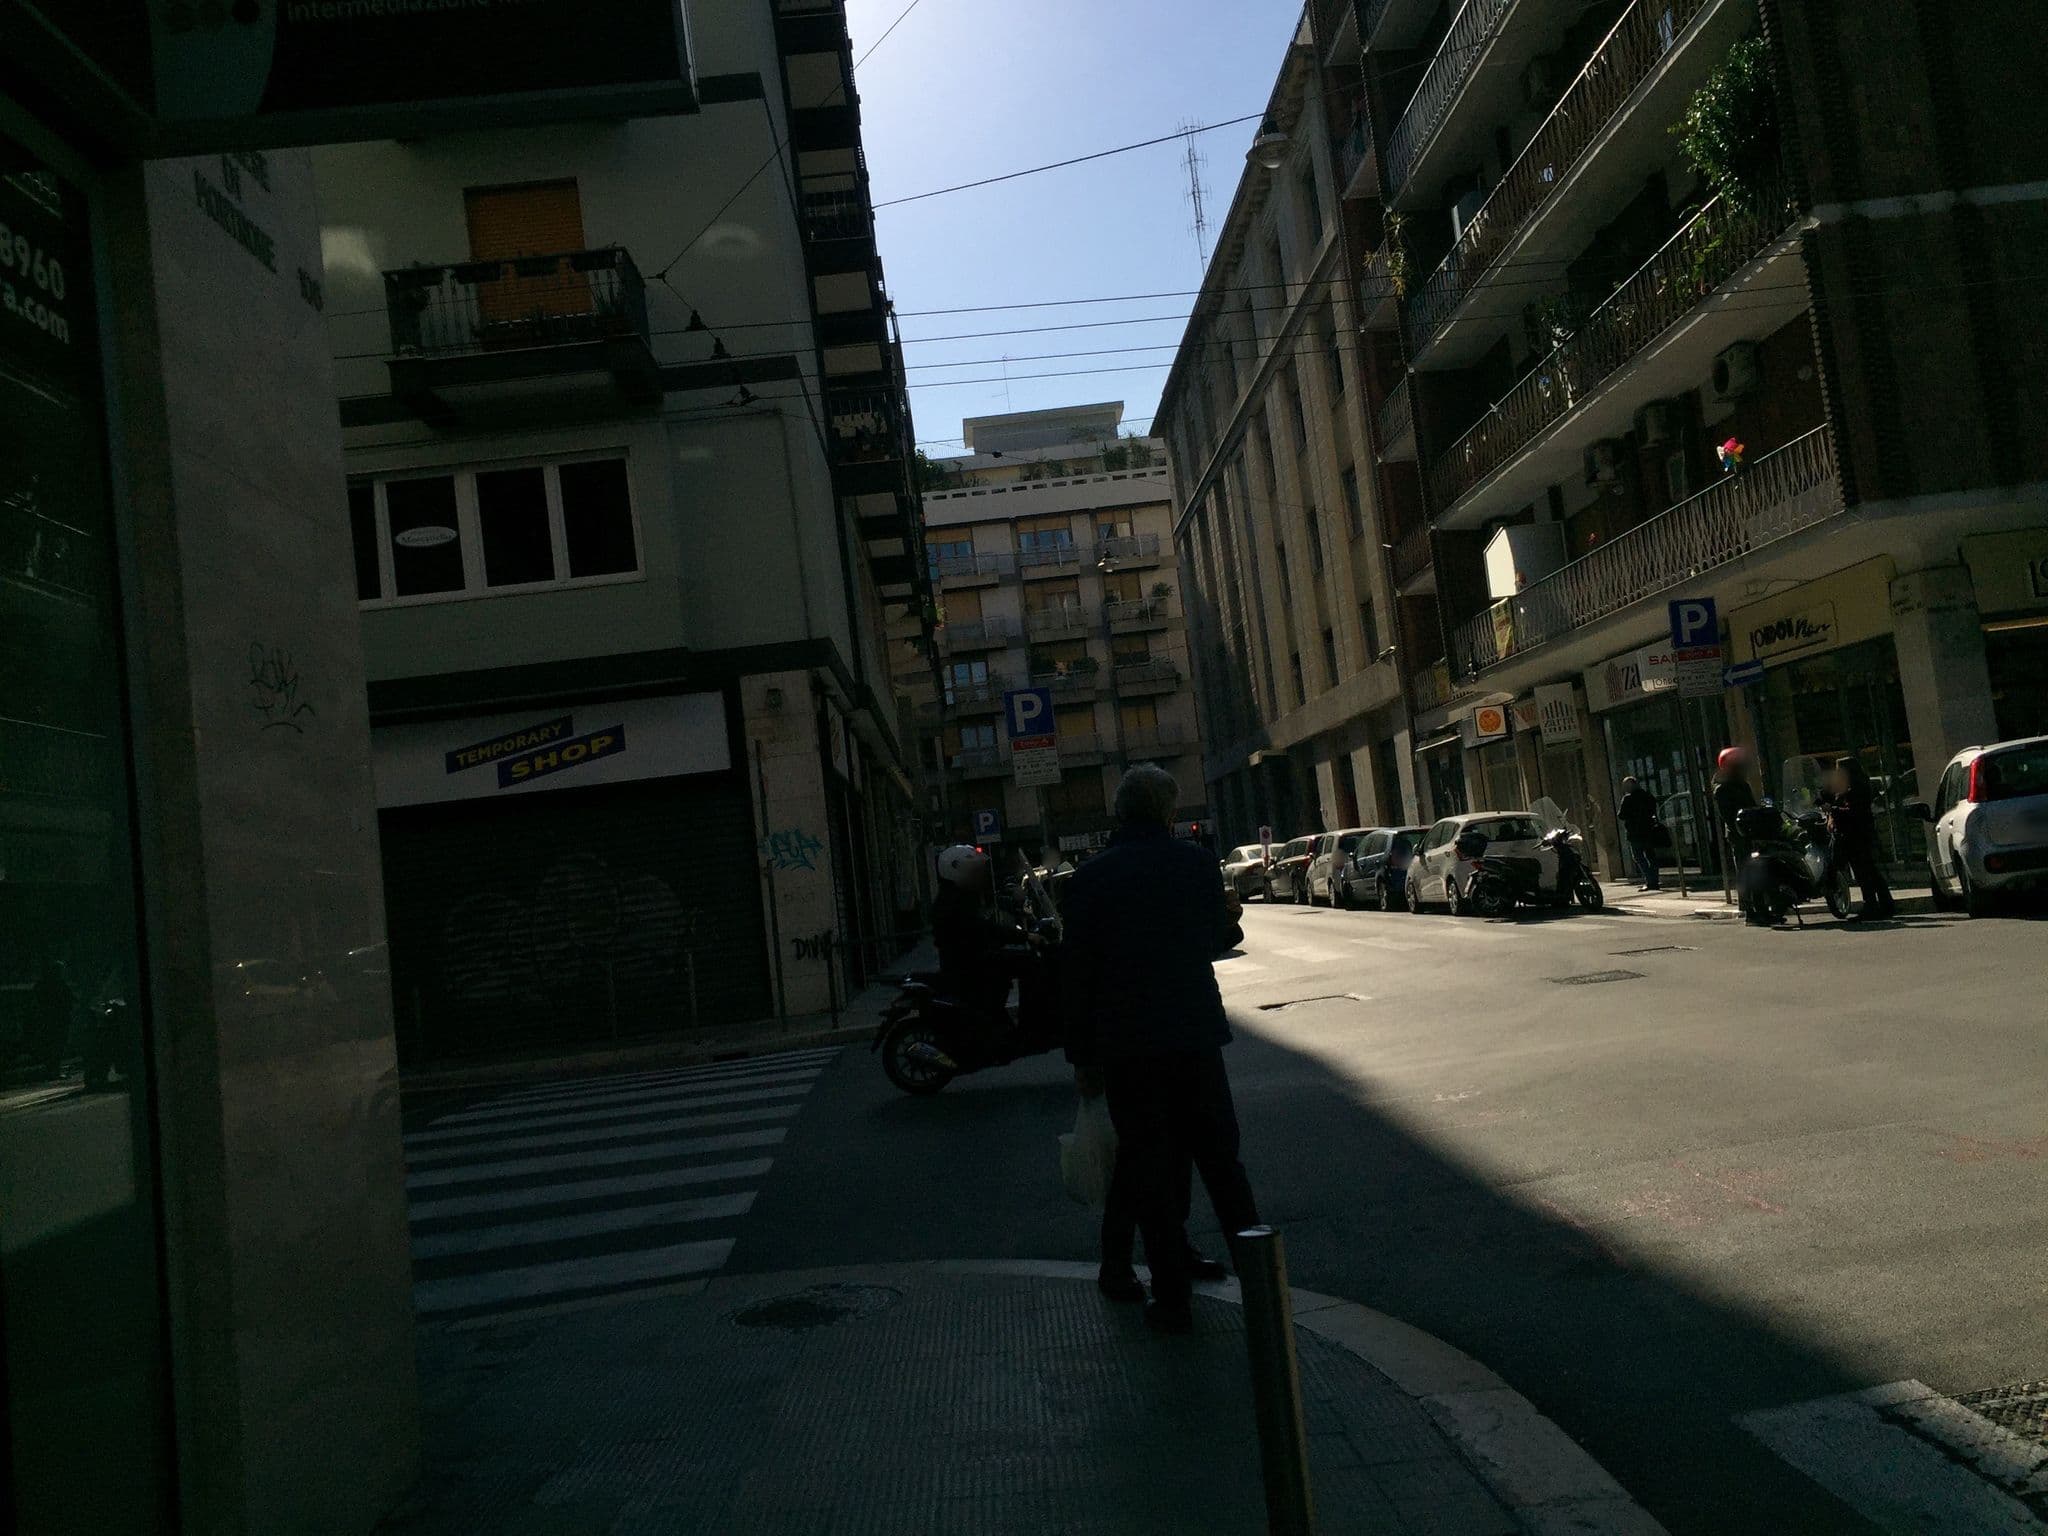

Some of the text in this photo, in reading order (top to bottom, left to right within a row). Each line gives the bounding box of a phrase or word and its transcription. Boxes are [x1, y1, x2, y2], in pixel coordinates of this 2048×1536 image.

[1679, 604, 1708, 643] P
[1014, 693, 1043, 733] P
[456, 722, 562, 768] TEMPORARY
[511, 735, 616, 780] SHOP
[979, 812, 994, 833] P
